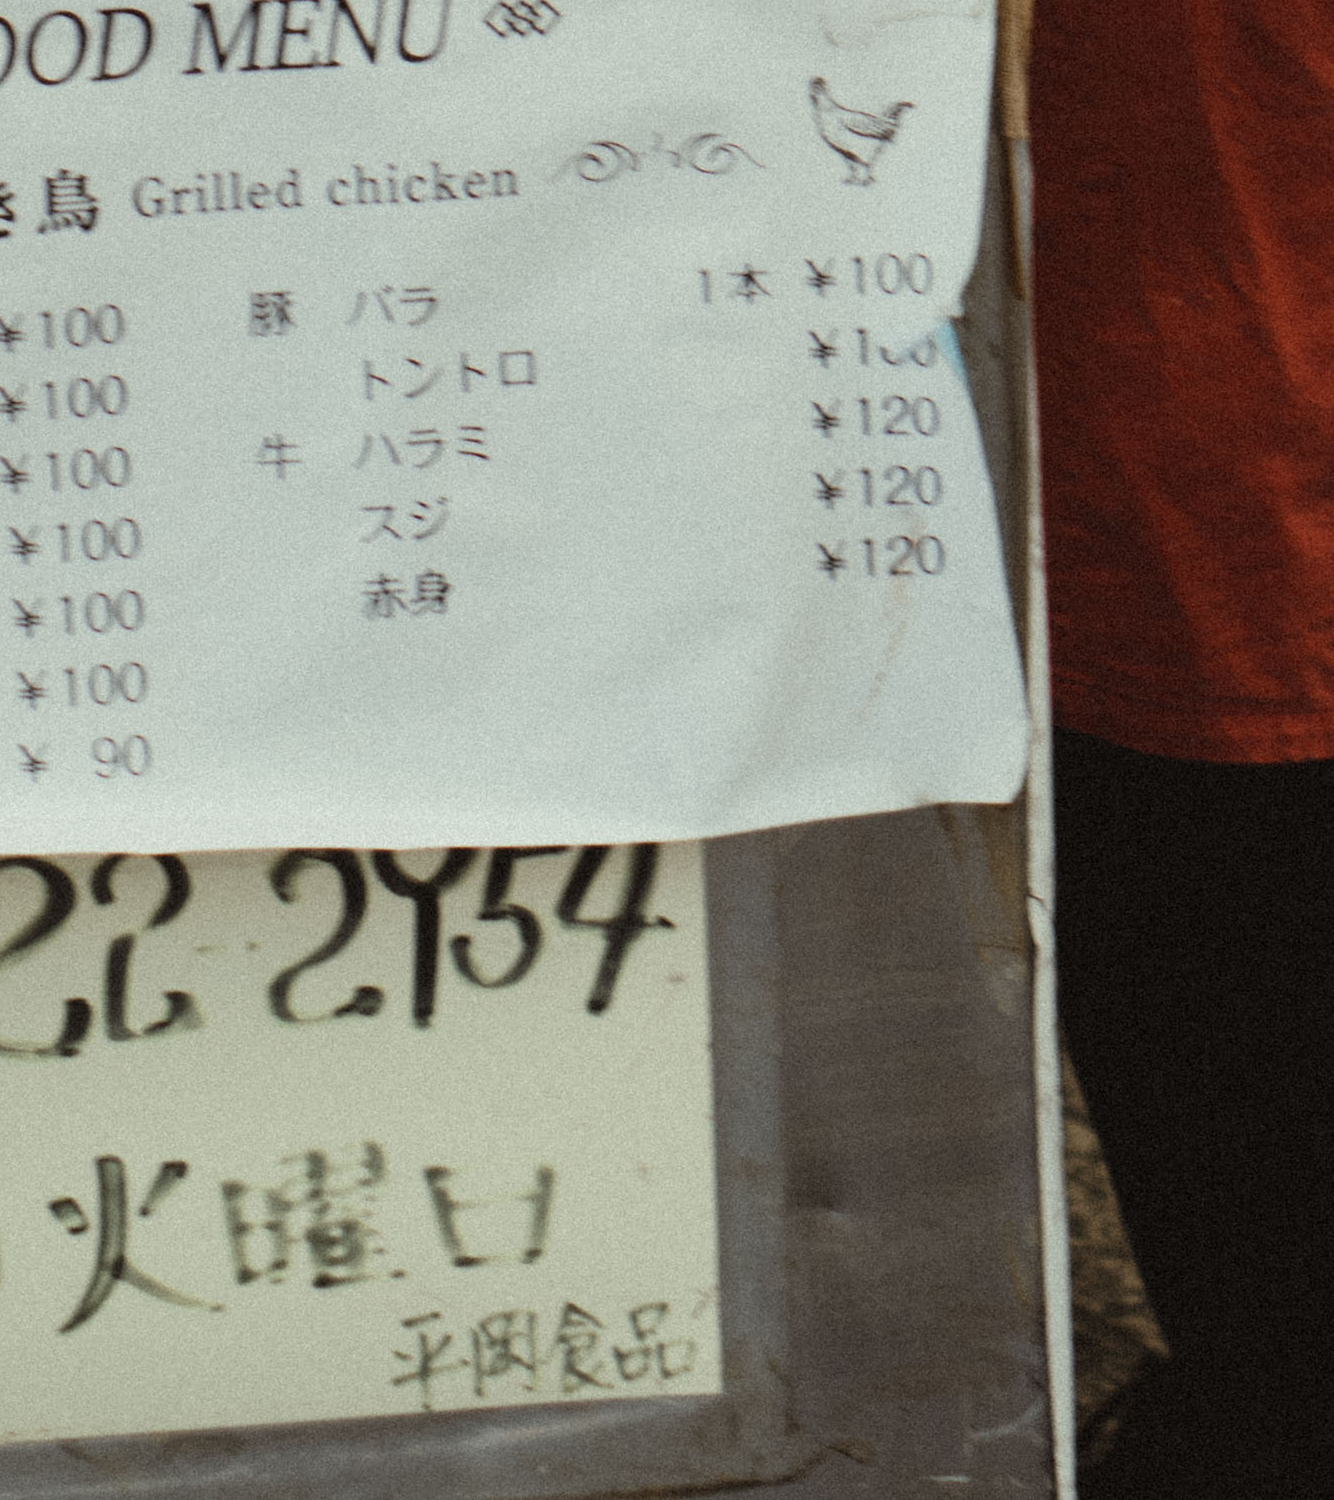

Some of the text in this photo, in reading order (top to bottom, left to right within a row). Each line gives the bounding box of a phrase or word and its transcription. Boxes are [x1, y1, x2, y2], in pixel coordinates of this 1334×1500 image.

[132, 166, 305, 220] Grilled
[326, 162, 521, 209] chicken
[248, 252, 935, 338] 豚 バラ 1本 ¥100
[362, 349, 538, 402] トントロ
[253, 395, 941, 481] 牛 ハラミ ¥120
[0, 445, 133, 494] ¥100
[361, 465, 945, 545] スジ ¥120
[8, 516, 143, 564] ¥100
[361, 535, 948, 621] 赤身 ¥120
[13, 588, 146, 637] ¥100
[15, 660, 150, 710] ¥100
[48, 1138, 559, 1334] 火曜日
